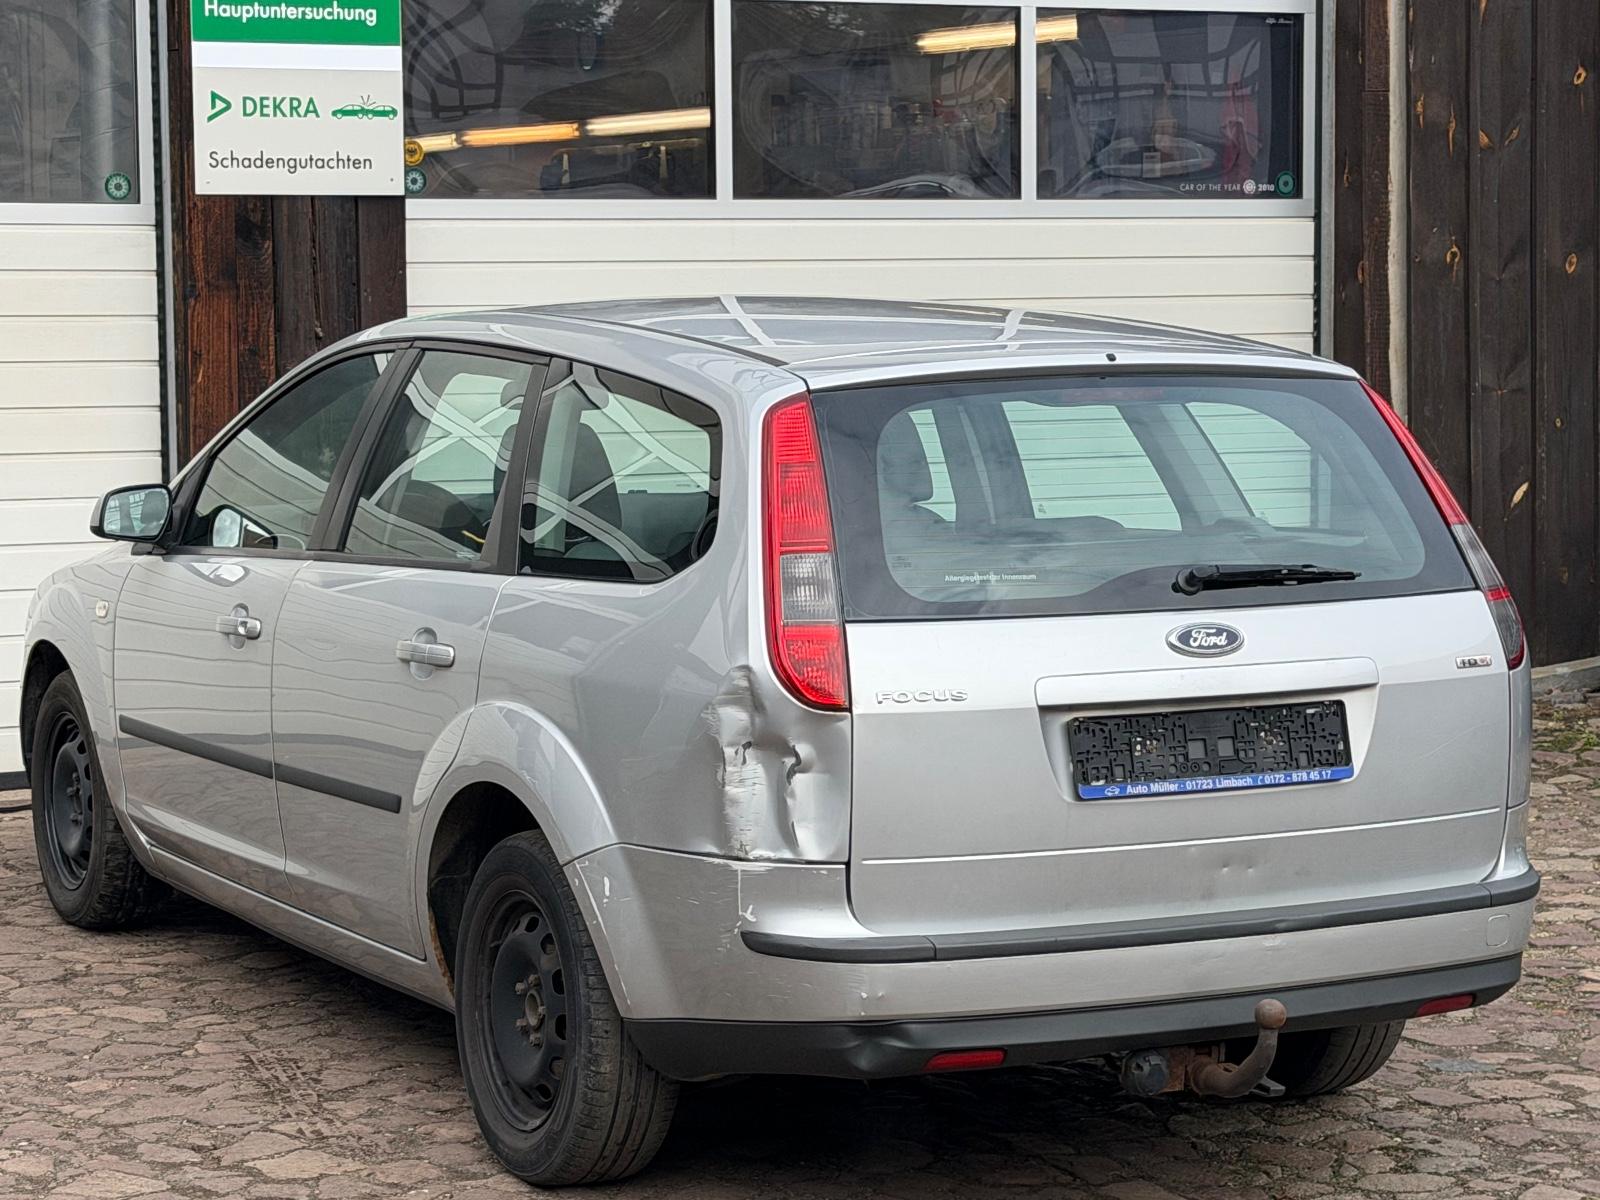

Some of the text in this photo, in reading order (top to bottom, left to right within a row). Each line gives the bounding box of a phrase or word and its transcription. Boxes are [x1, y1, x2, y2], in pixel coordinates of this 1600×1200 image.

[204, 0, 377, 26] Hauptuntersuchung
[242, 96, 320, 118] DEKRA
[208, 150, 373, 174] Schadengutachten
[1189, 629, 1228, 647] Ford
[876, 688, 968, 704] FOCUS
[1126, 784, 1148, 794] Auto
[1150, 781, 1179, 793] Müller
[1186, 779, 1213, 790] 01723
[1216, 776, 1253, 788] Limbach
[1265, 774, 1286, 784] 0172
[1309, 771, 1320, 780] 45
[1321, 770, 1332, 779] 17
